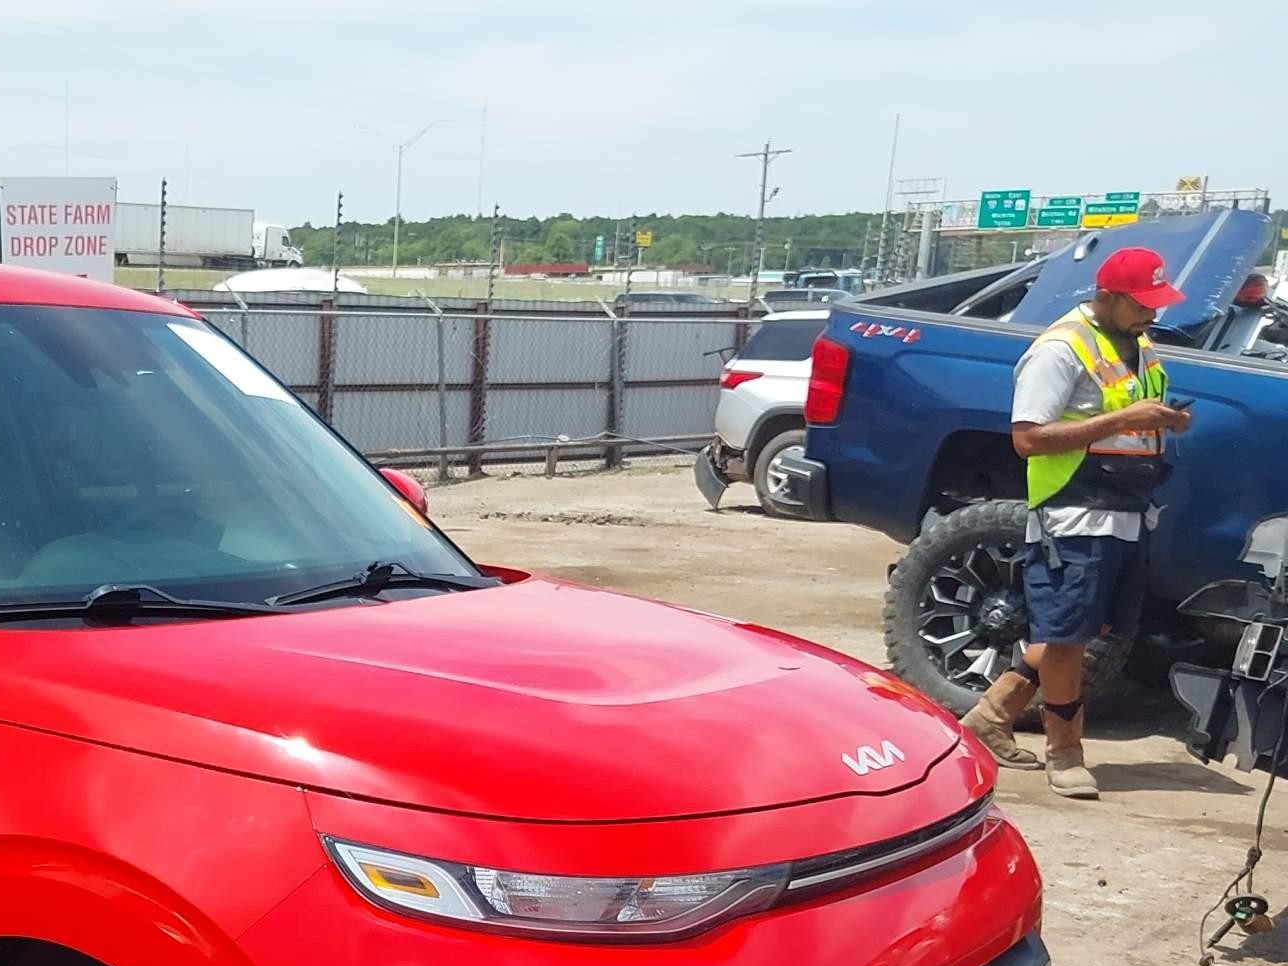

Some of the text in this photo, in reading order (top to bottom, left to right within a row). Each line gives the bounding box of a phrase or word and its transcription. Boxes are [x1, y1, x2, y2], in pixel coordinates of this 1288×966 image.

[6, 204, 111, 226] STATE FARM
[10, 235, 108, 257] DROP ZONE
